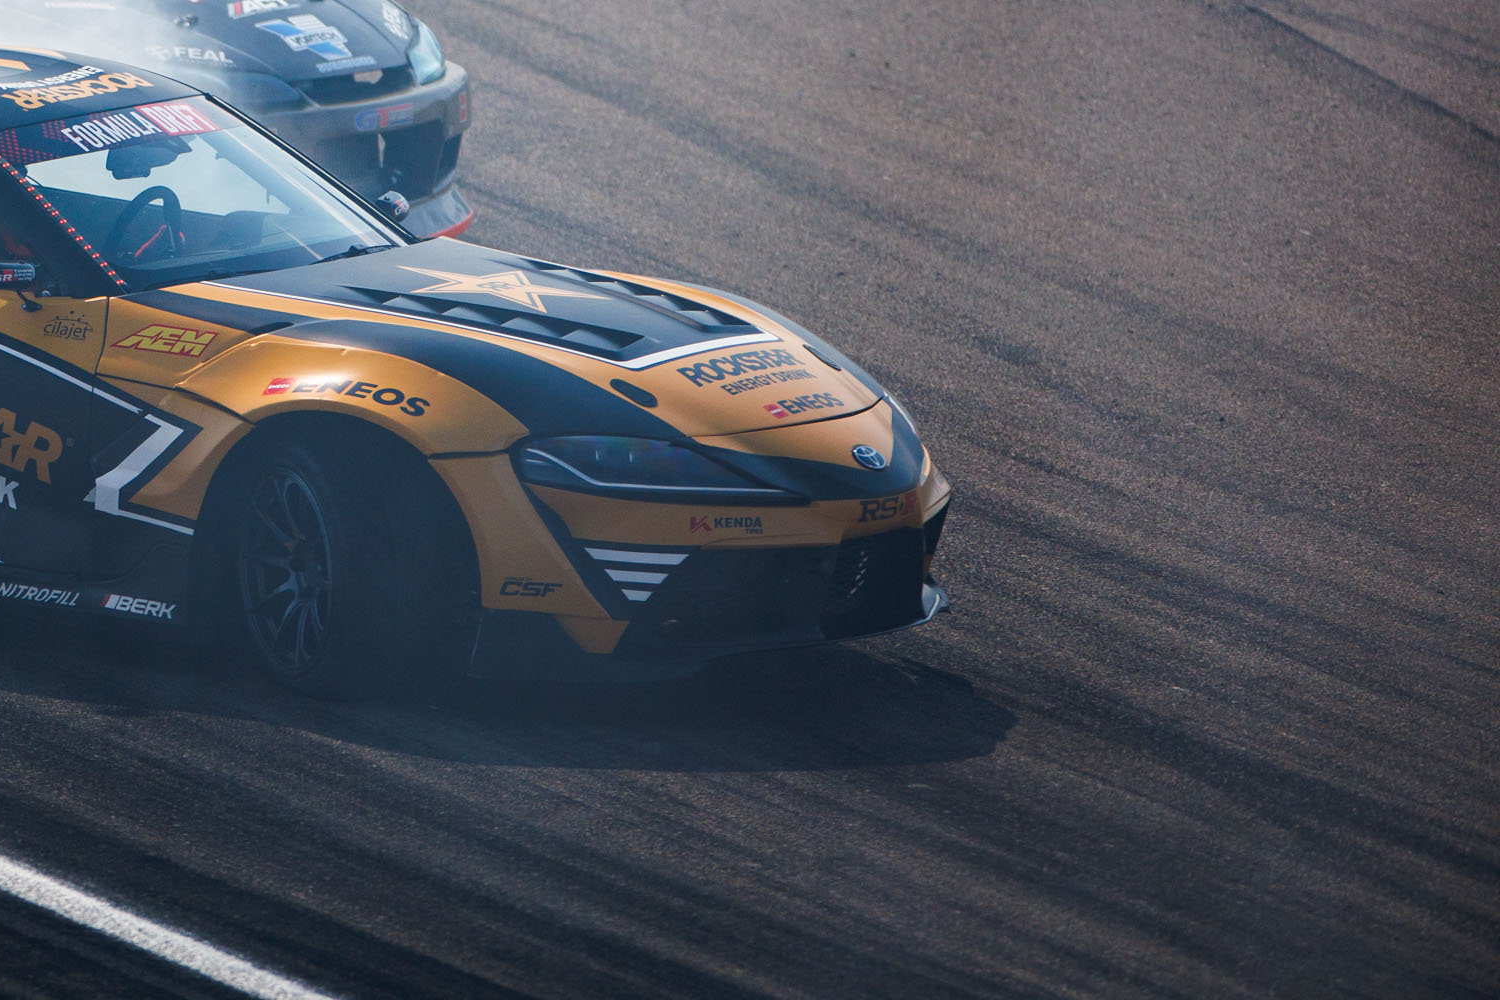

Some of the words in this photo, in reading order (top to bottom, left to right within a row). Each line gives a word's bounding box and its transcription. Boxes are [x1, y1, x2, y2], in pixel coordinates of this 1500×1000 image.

[173, 46, 234, 63] FEAL
[2, 72, 154, 109] ROCKSTAR
[61, 111, 163, 152] FORMULA
[140, 104, 216, 133] DRIFT
[44, 322, 88, 339] cilajet
[110, 323, 219, 358] AEM
[676, 349, 805, 387] ROCKSTAR
[720, 373, 777, 395] ENERGY
[773, 369, 816, 384] DRINK
[292, 380, 430, 417] ENEOS
[777, 392, 844, 414] ENEOS
[713, 516, 762, 528] KENDA
[500, 581, 563, 597] CSF
[115, 596, 176, 619] BERK
